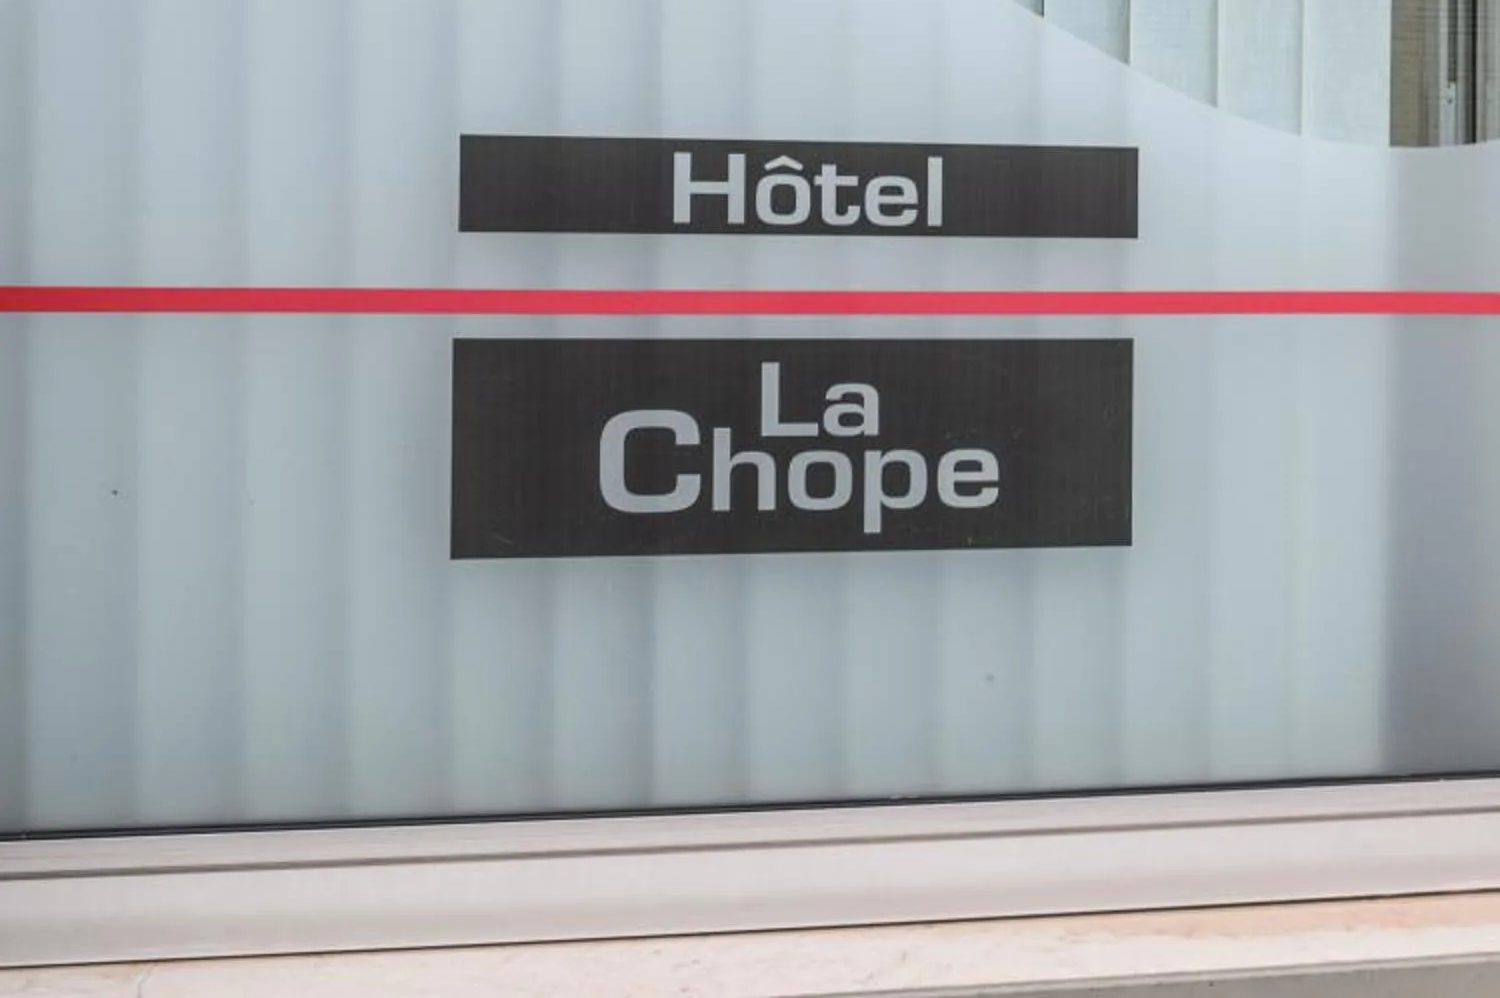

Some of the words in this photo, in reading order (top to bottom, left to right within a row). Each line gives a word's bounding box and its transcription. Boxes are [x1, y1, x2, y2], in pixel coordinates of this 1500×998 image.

[672, 152, 944, 227] Hôtel
[760, 361, 881, 438] La
[599, 409, 1000, 534] Chope
